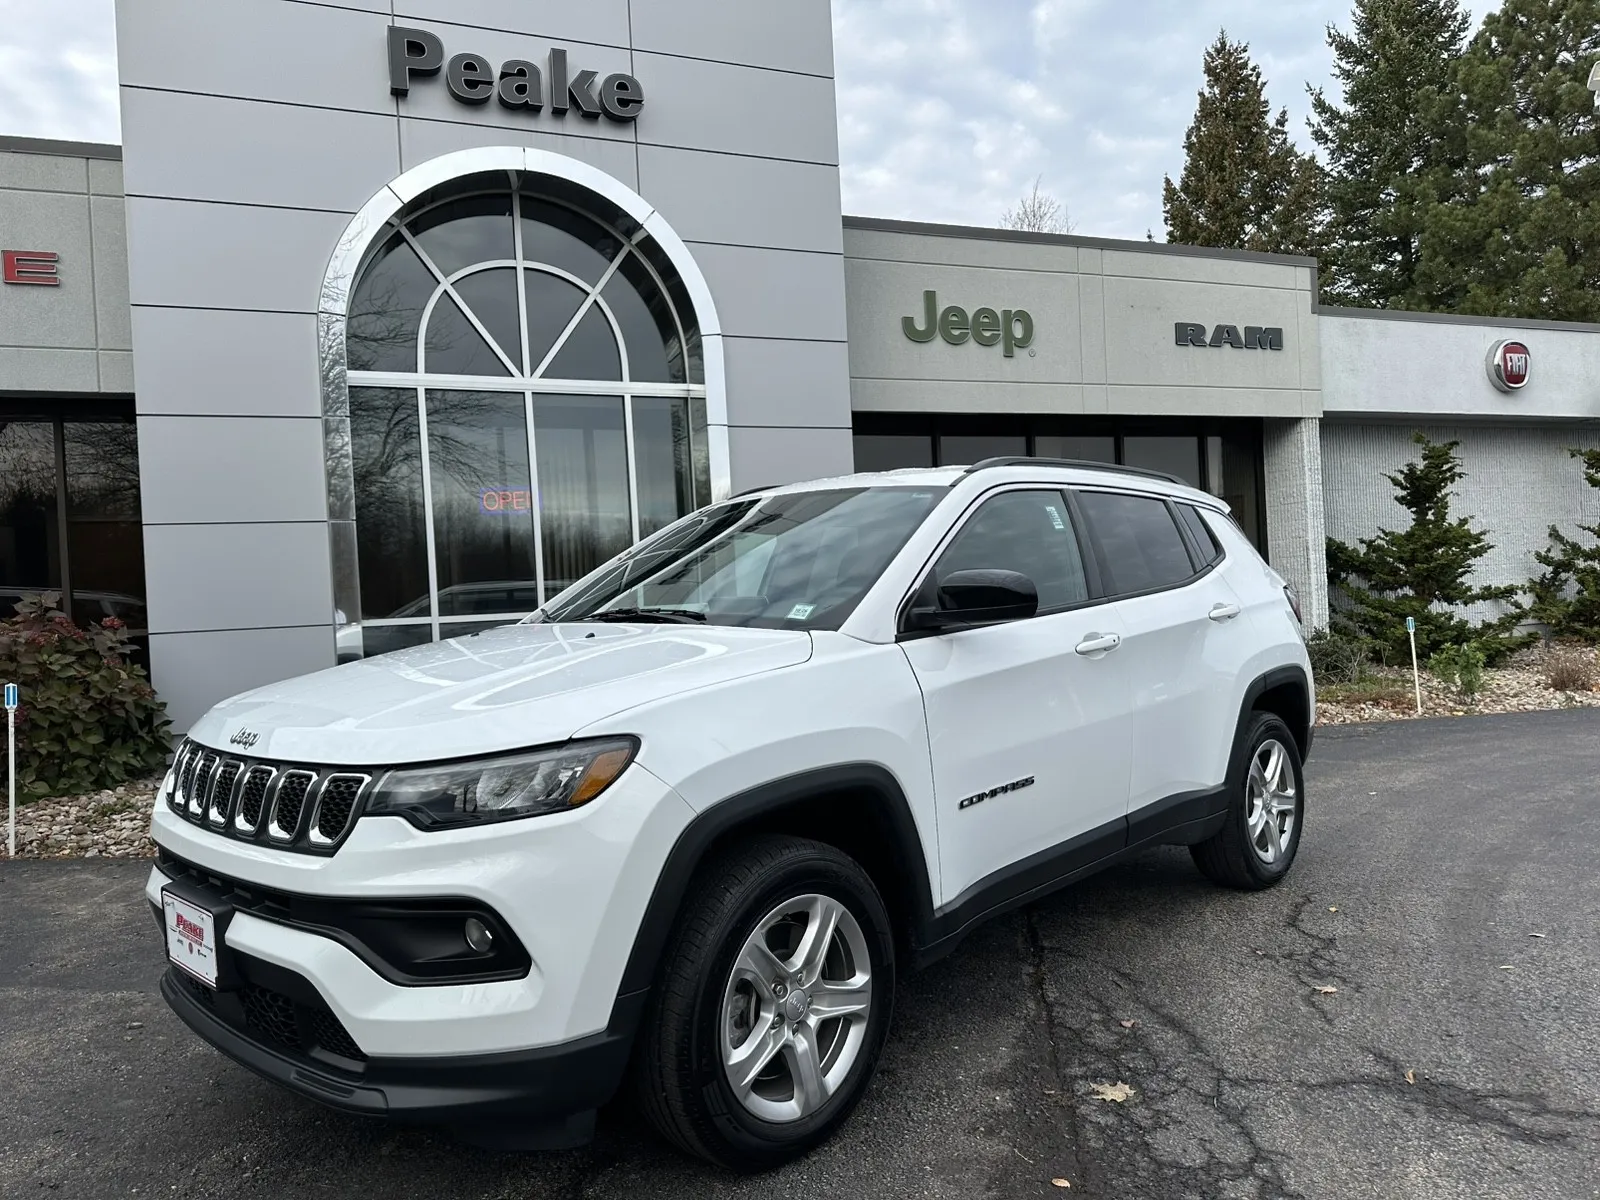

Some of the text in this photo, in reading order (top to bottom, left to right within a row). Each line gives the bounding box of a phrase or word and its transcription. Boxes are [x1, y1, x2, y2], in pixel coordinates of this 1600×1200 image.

[387, 25, 644, 122] Peake
[901, 290, 1034, 357] Jeep
[1175, 322, 1283, 350] RAM
[1505, 353, 1525, 375] FIAT
[230, 727, 260, 750] Jeep
[958, 775, 1035, 810] COMPASS
